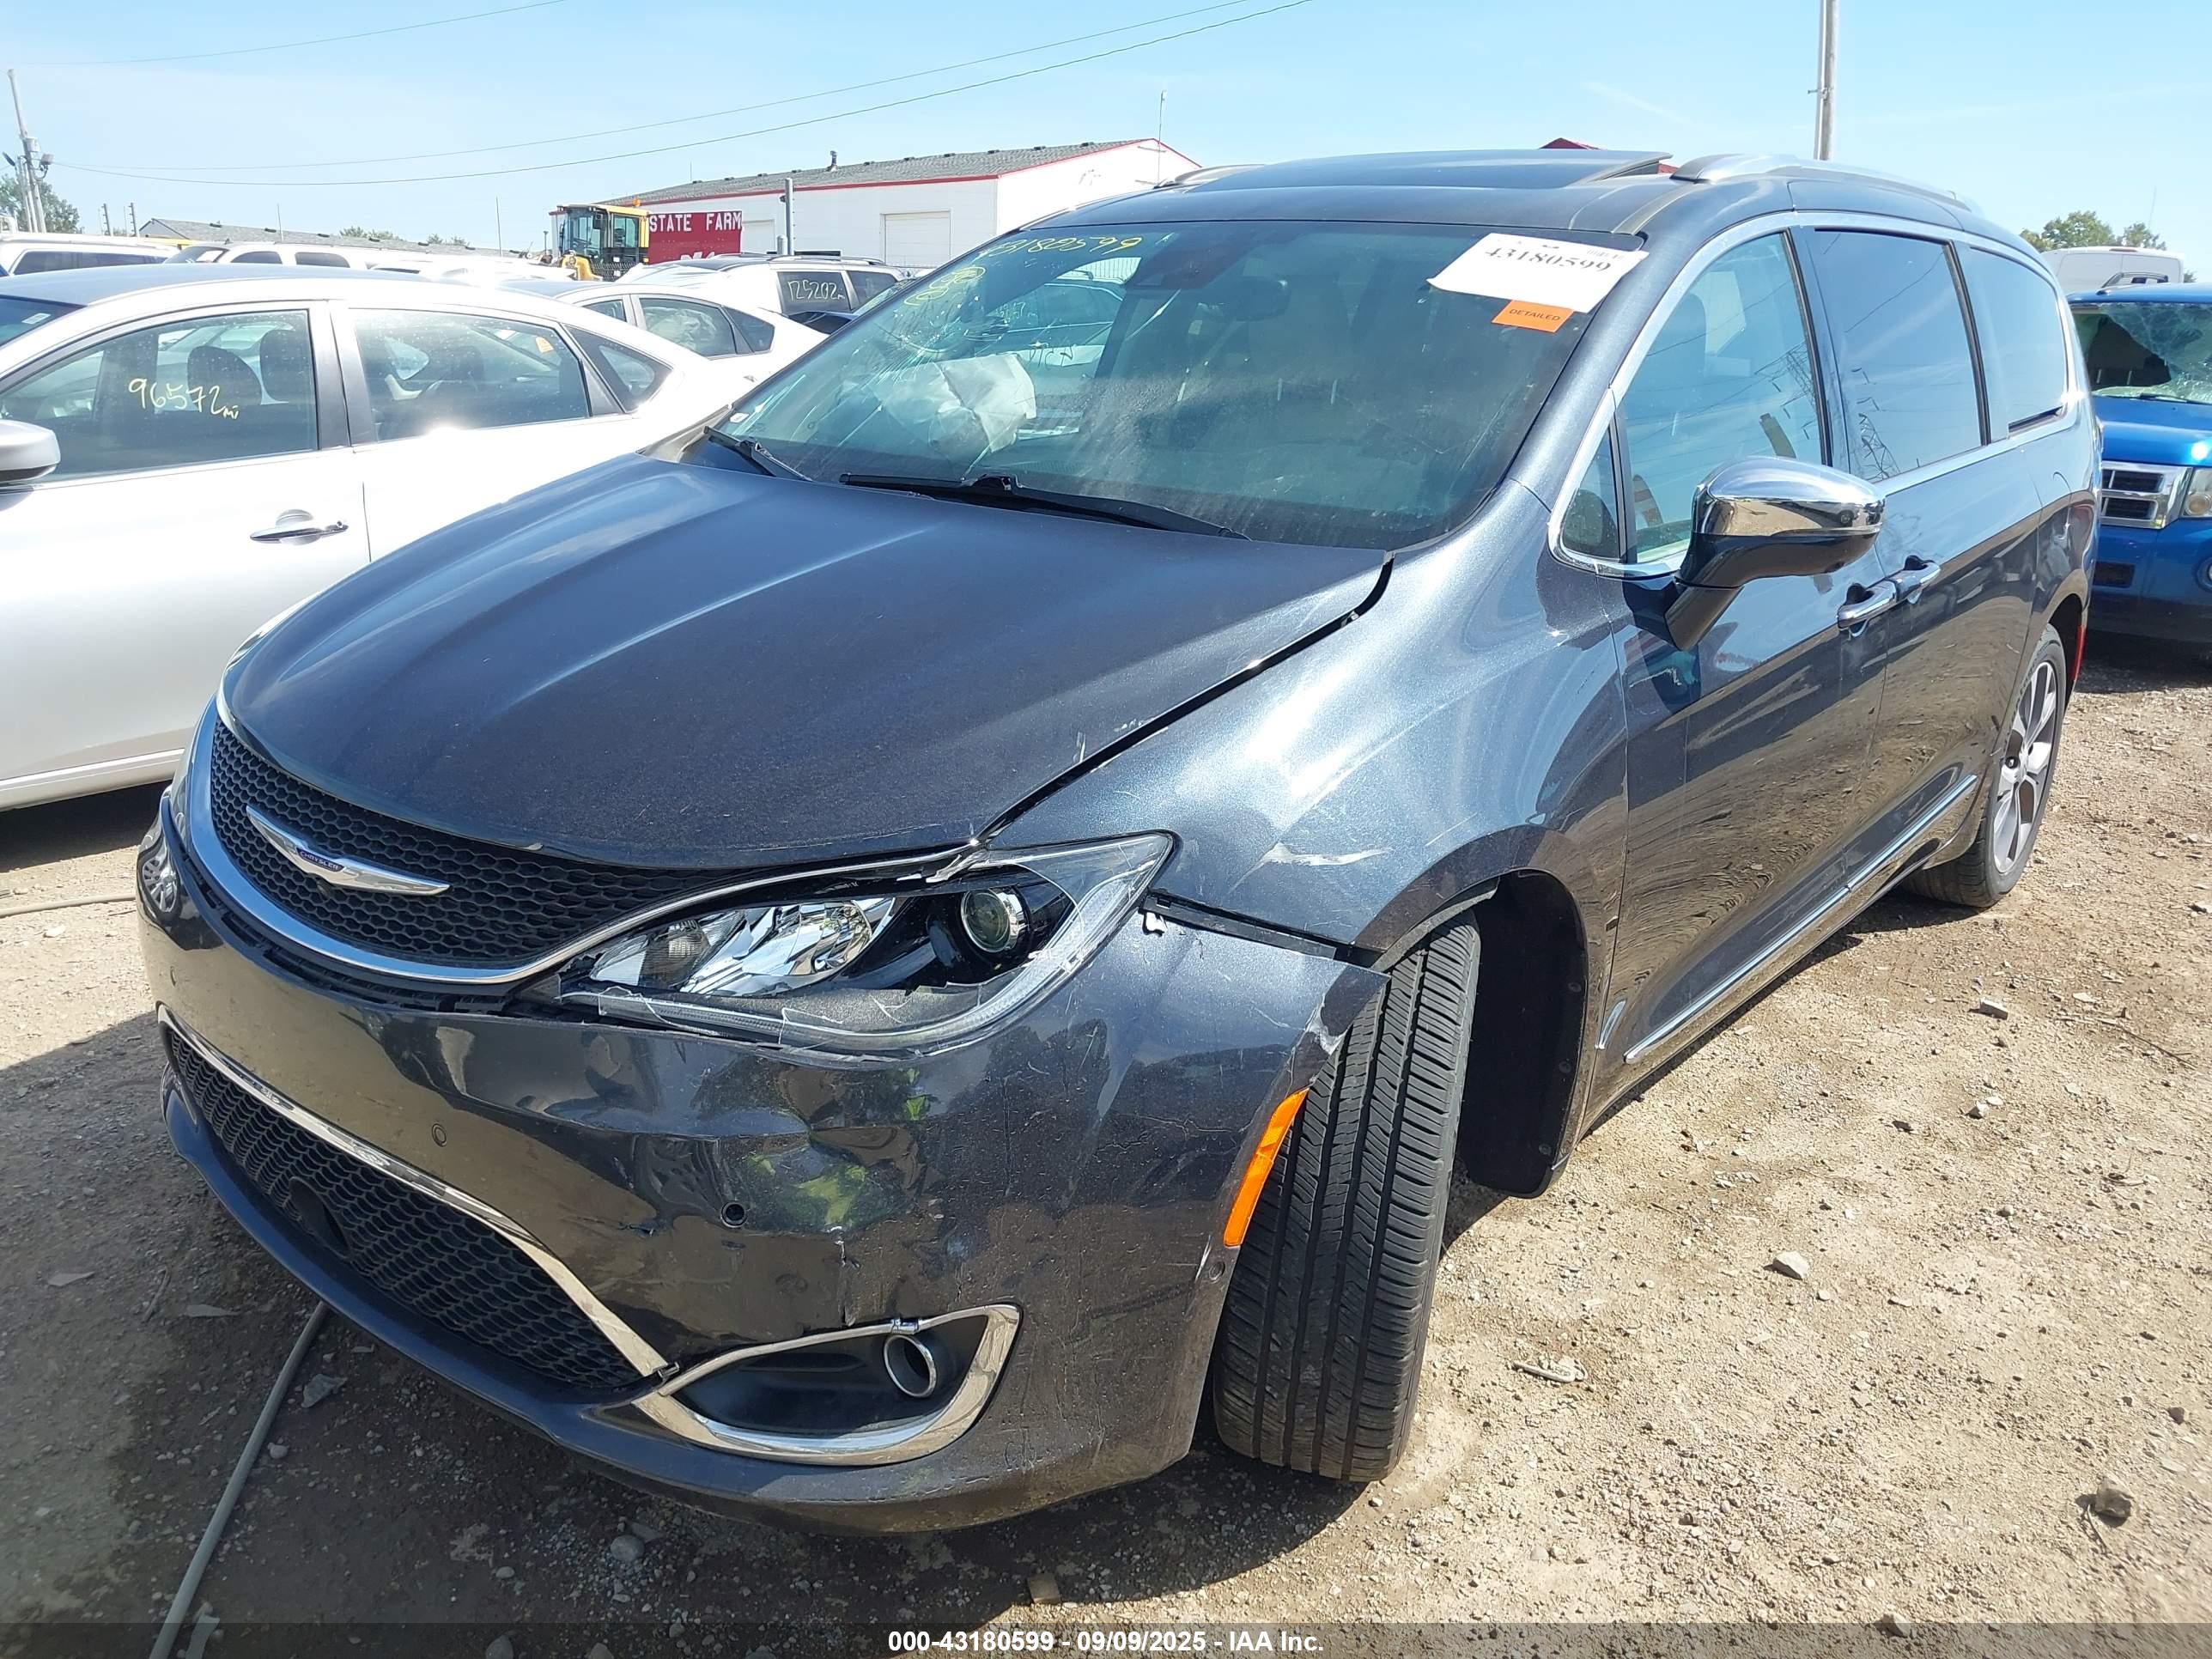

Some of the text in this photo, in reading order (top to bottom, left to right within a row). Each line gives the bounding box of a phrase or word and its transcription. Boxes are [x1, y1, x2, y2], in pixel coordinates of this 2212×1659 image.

[649, 211, 742, 232] STATE FARM
[1485, 247, 1611, 271] 43180599
[1509, 308, 1560, 321] DETAILED
[300, 850, 339, 870] CHRYSLER
